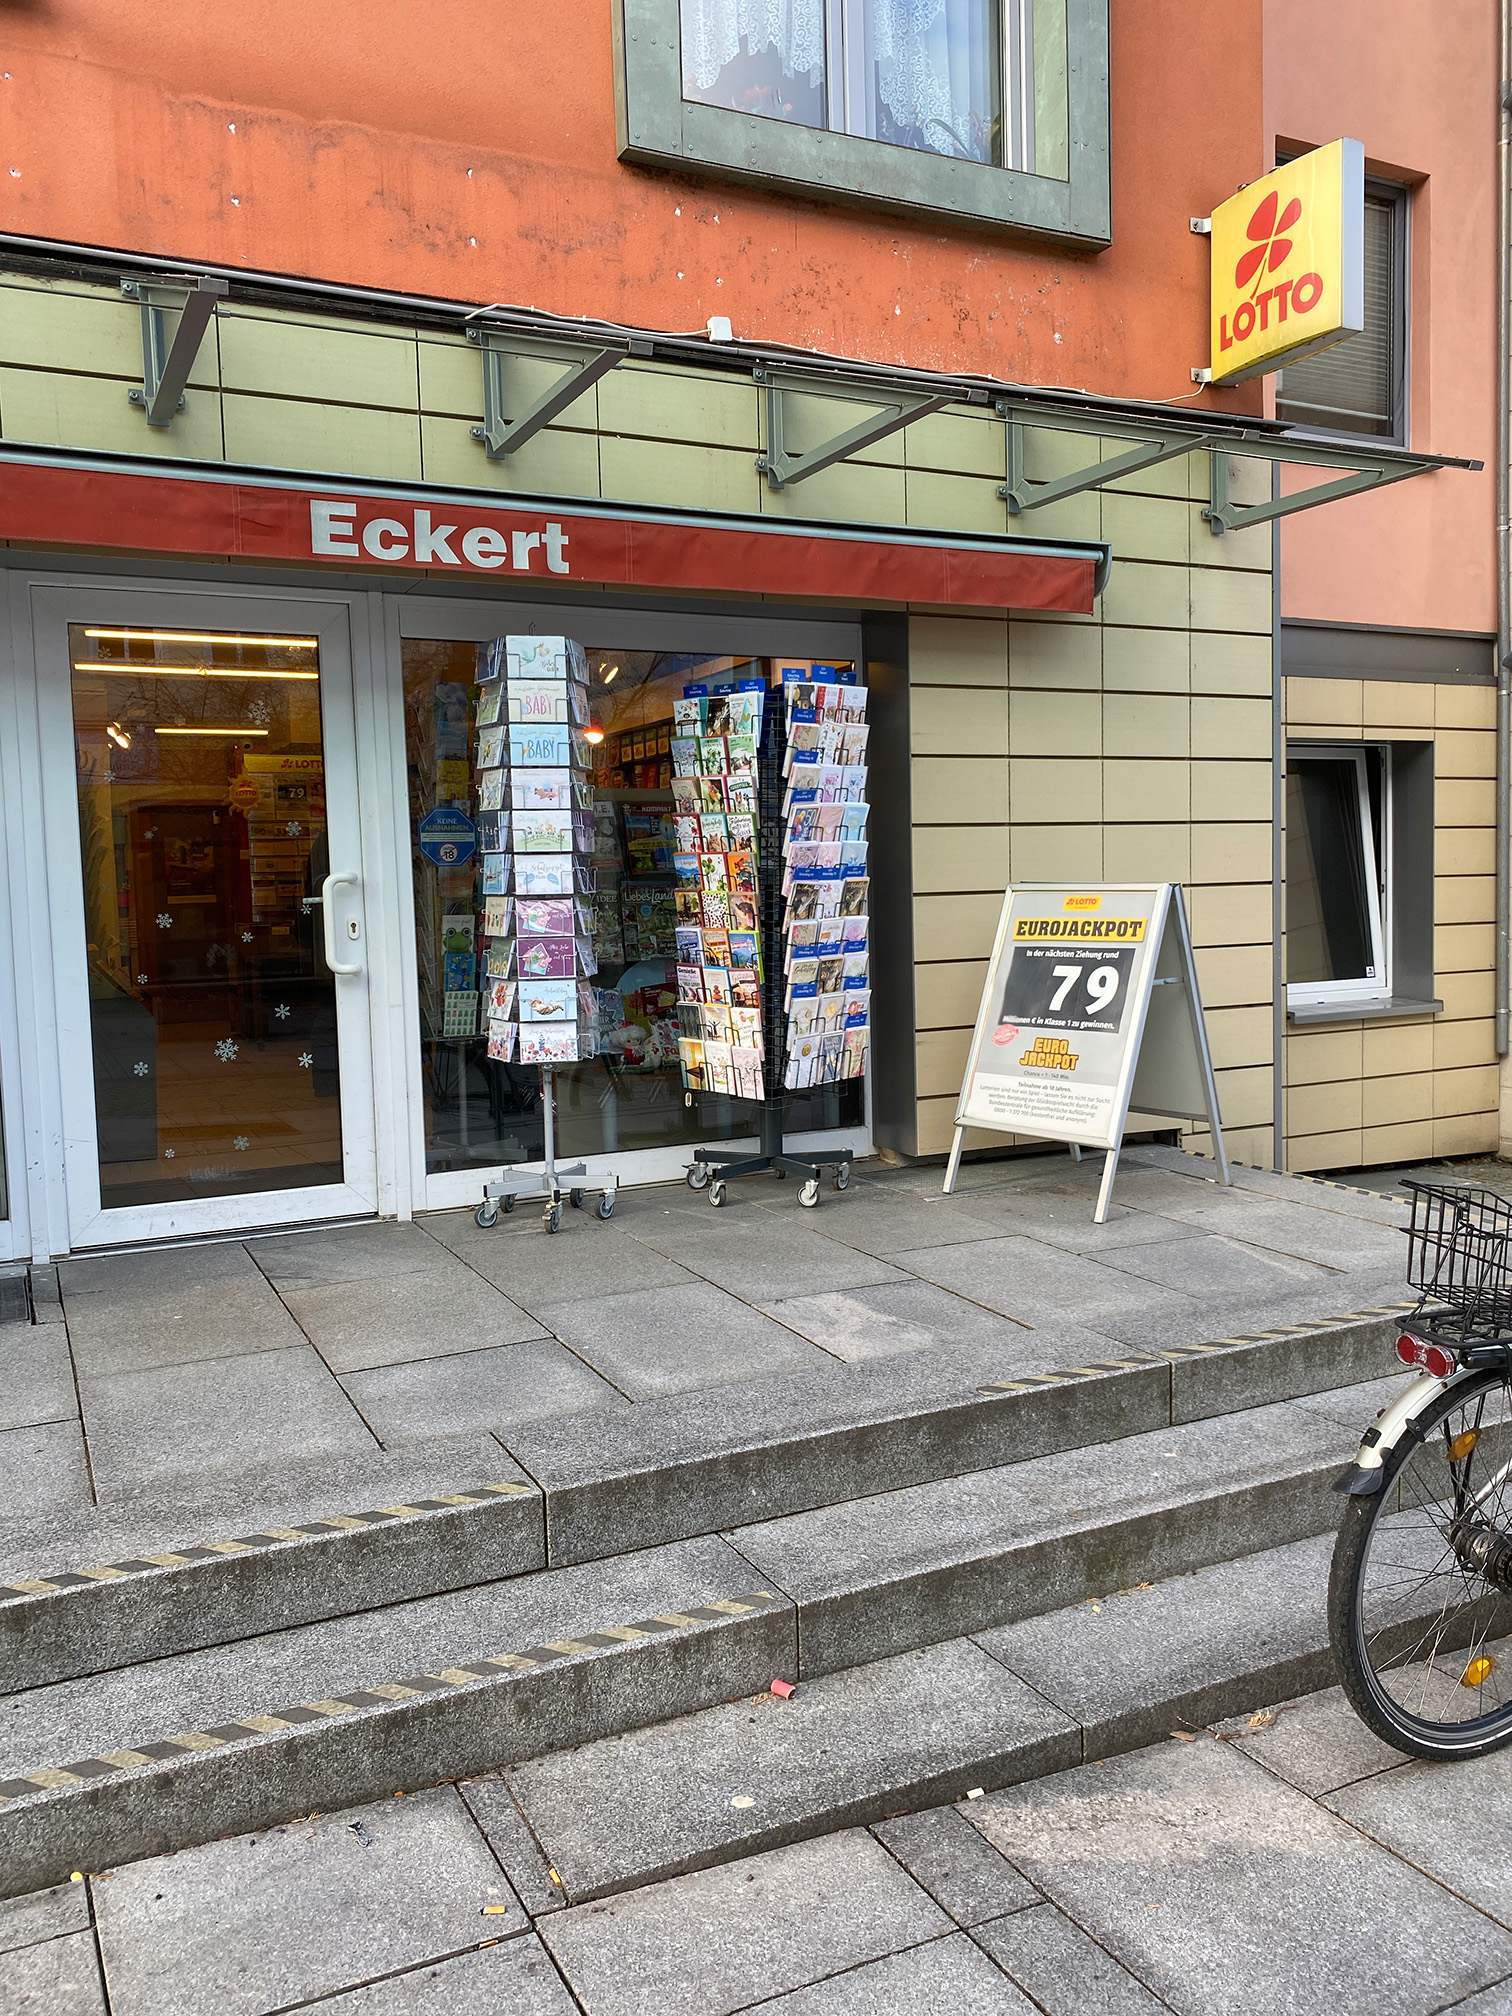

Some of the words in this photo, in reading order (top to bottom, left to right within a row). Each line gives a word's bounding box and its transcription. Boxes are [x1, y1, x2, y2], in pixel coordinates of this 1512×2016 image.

[1220, 272, 1324, 352] LOTTO
[309, 498, 570, 574] Eckert
[525, 695, 552, 715] BABY
[527, 739, 555, 759] BABY
[288, 787, 305, 798] 79
[803, 809, 817, 826] 50
[443, 850, 455, 860] 18
[1016, 920, 1143, 938] EUROJACKPOT
[1026, 949, 1033, 957] In
[1033, 950, 1045, 958] der
[1045, 949, 1075, 958] nächsten
[1075, 951, 1102, 960] Ziehung
[1103, 951, 1119, 959] rund
[1048, 965, 1119, 1016] 79
[1030, 1016, 1037, 1024] €
[1037, 1016, 1043, 1024] in
[1044, 1017, 1067, 1026] Klasse
[1080, 1020, 1115, 1030] gewinnen.
[1034, 1037, 1069, 1055] EURO
[1019, 1050, 1079, 1071] JACKPOT
[989, 1099, 1023, 1108] Bundeszentrale
[1031, 1105, 1068, 1114] gesundheitliche
[1007, 1094, 1028, 1102] Beratung
[1036, 1098, 1075, 1107] Glücksspielsucht
[1029, 1111, 1055, 1120] (kostenfrei
